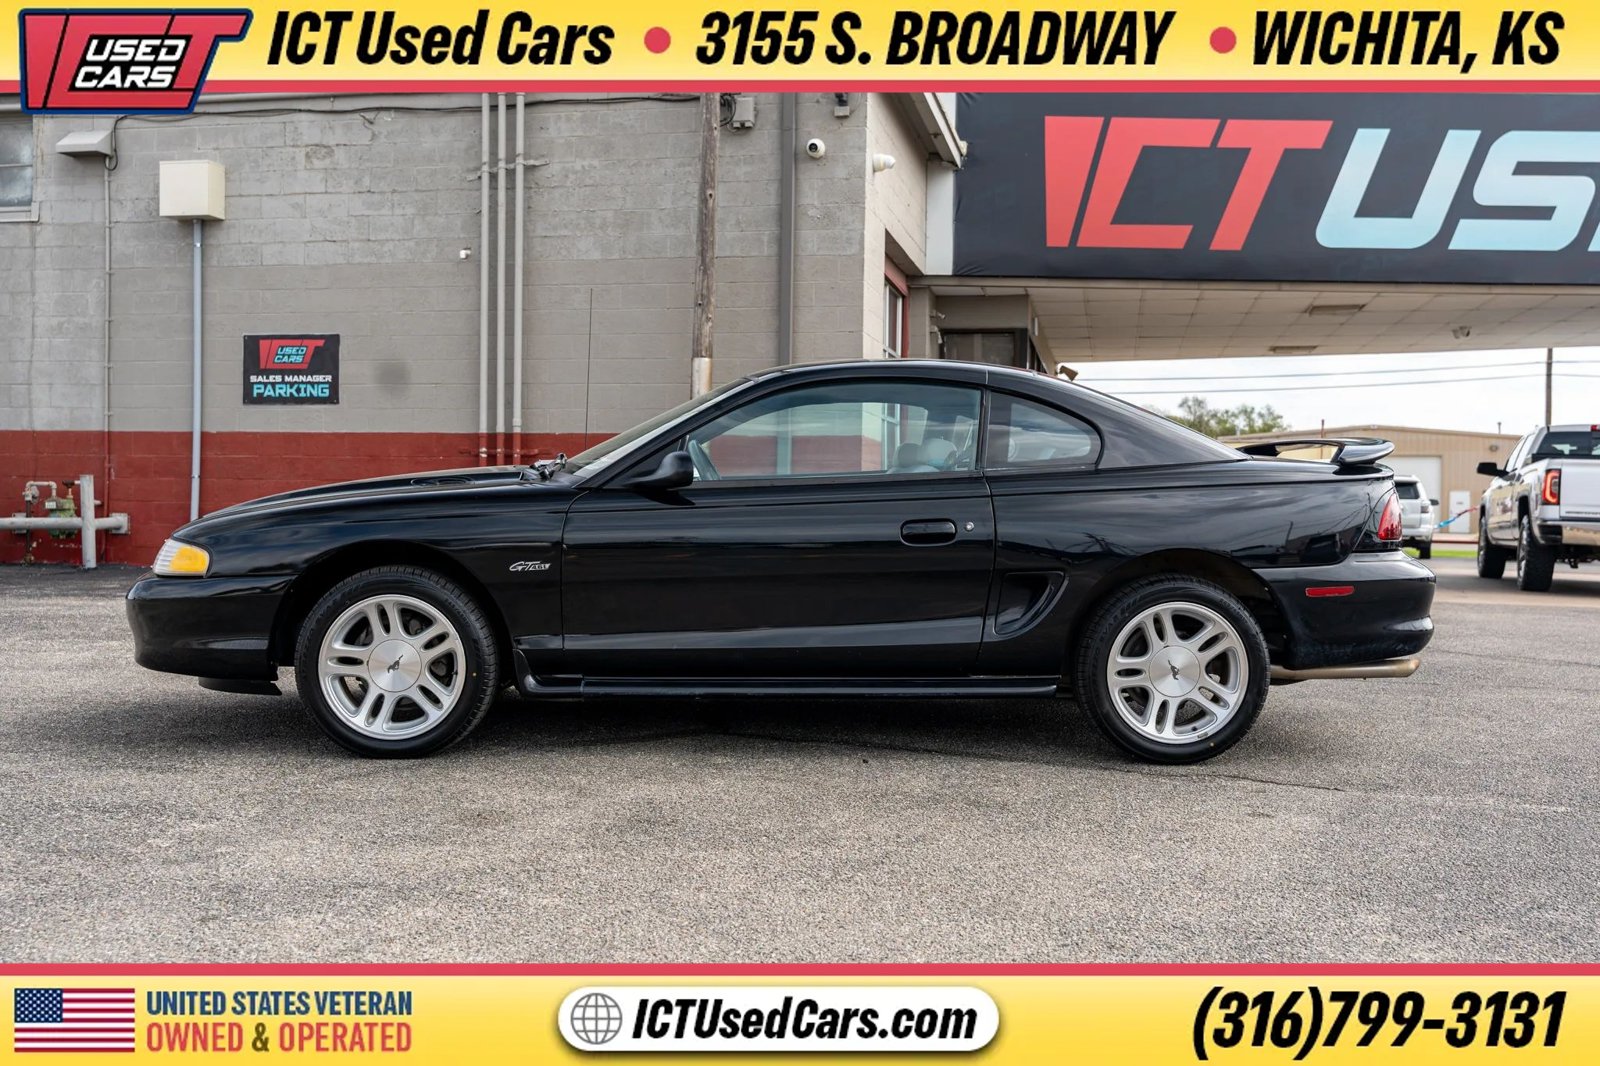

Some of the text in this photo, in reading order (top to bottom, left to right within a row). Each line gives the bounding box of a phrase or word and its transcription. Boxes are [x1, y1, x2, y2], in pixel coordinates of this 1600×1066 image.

[1045, 116, 1600, 251] ICT US
[277, 346, 307, 355] USED
[274, 355, 303, 363] CARS
[250, 375, 332, 383] SALES MANAGER
[253, 384, 330, 397] PARKING
